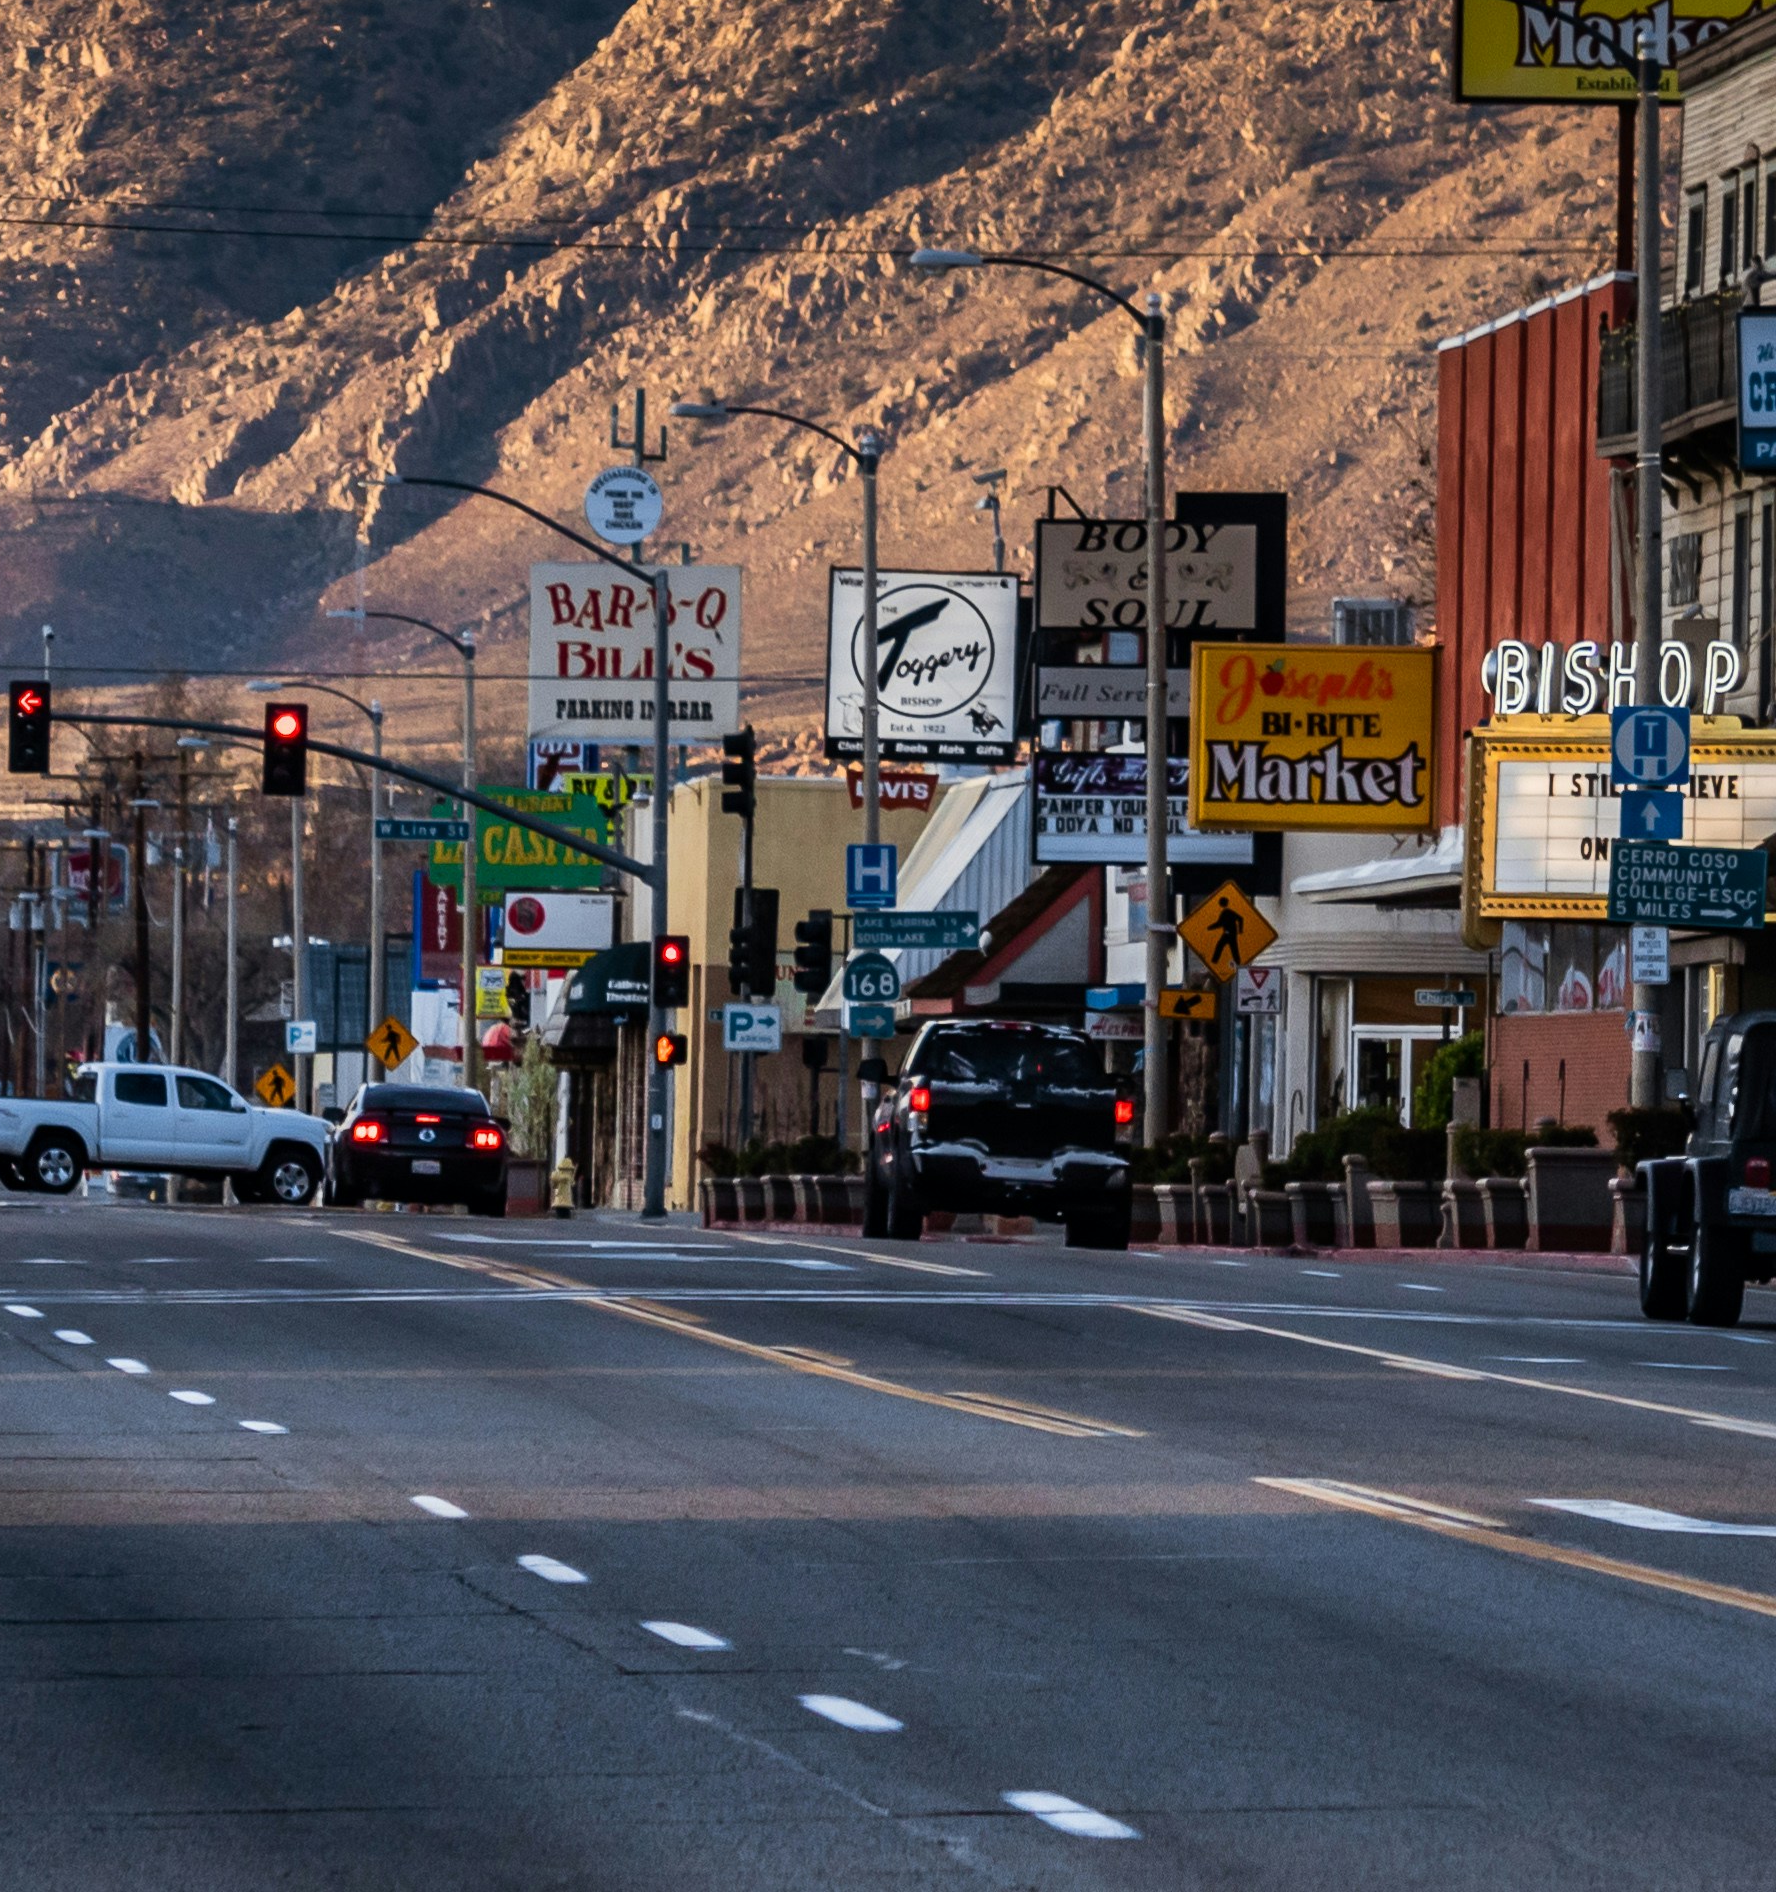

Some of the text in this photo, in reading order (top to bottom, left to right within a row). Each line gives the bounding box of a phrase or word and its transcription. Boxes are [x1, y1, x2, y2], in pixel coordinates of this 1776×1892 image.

[881, 606, 899, 616] THE
[877, 597, 987, 693] Toggery
[1493, 639, 1741, 716] BISHOP
[900, 696, 943, 708] BISHOP
[1040, 683, 1181, 703] Full Serve
[556, 698, 634, 722] PARKING
[667, 700, 713, 721] REAR
[895, 742, 928, 755] Boots
[938, 743, 966, 756] Hats
[976, 744, 1004, 757] Gifts
[1205, 737, 1426, 808] Market
[855, 780, 929, 800] LVI'S
[1548, 773, 1555, 798] I
[1037, 798, 1189, 816] PAMPER YOURELF
[379, 823, 466, 838] W Line St
[1618, 848, 1680, 867] CERRO
[1688, 852, 1739, 870] COSO
[854, 847, 890, 893] H
[1616, 866, 1729, 886] COMMUNITY
[1616, 883, 1758, 905] COLLEGE-ESCC
[1615, 900, 1692, 919] 5 MILES
[849, 972, 895, 997] 168
